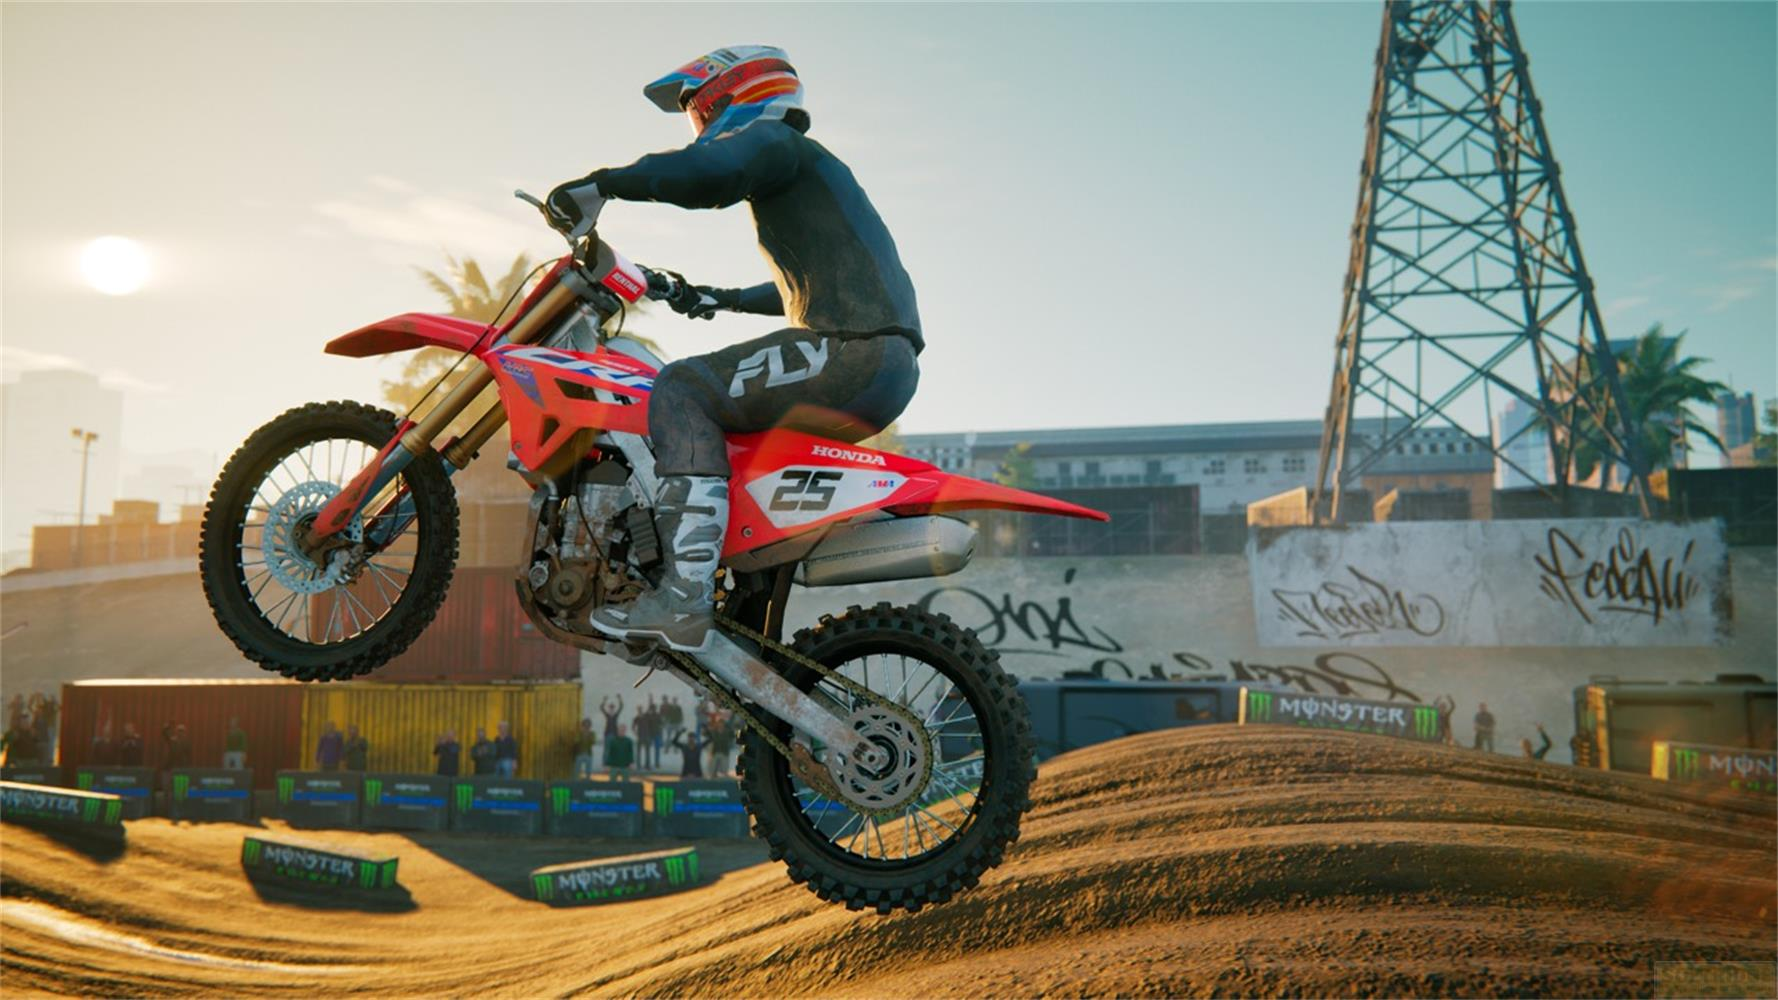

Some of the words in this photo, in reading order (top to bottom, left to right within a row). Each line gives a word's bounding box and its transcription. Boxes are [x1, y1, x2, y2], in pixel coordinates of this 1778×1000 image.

[728, 337, 828, 398] FLY
[811, 445, 887, 467] HONDA
[768, 470, 844, 512] 25
[1279, 697, 1407, 728] MONSTER
[264, 845, 355, 879] MONSTER
[558, 861, 661, 892] MONSTER
